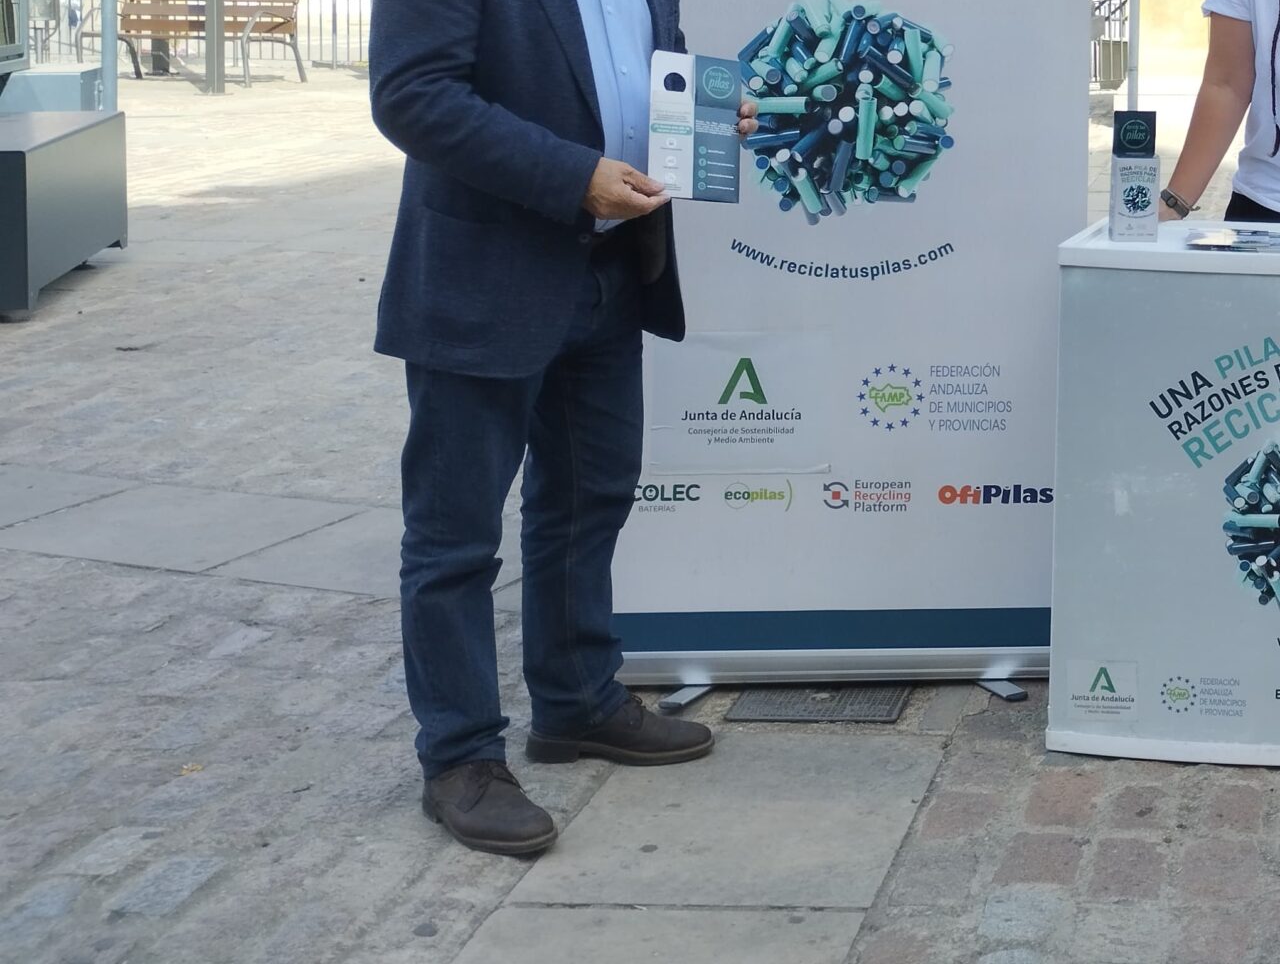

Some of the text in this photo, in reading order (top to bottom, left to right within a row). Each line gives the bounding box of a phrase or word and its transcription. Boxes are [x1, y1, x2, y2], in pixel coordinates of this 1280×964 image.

[730, 238, 954, 280] www.reciclatuspilas.com
[930, 363, 1001, 378] FEDERACIÓN
[929, 384, 988, 395] ANDALUZA
[1149, 370, 1214, 419] UNA
[929, 401, 1012, 413] DE MUNICIPIOS
[1167, 370, 1270, 441] RAZONES
[681, 408, 802, 421] Junta de Andalucía
[729, 427, 739, 435] de
[740, 427, 795, 435] Sostenibilidad
[928, 419, 1006, 431] Y PROVINCIAS
[714, 436, 737, 444] Medio
[738, 436, 775, 444] Ambiente
[854, 479, 911, 492] European
[634, 484, 701, 502] COLEC
[724, 488, 785, 503] ecopilas
[854, 489, 911, 503] Recycling
[854, 501, 907, 512] Platform
[1100, 694, 1135, 703] Andalucía
